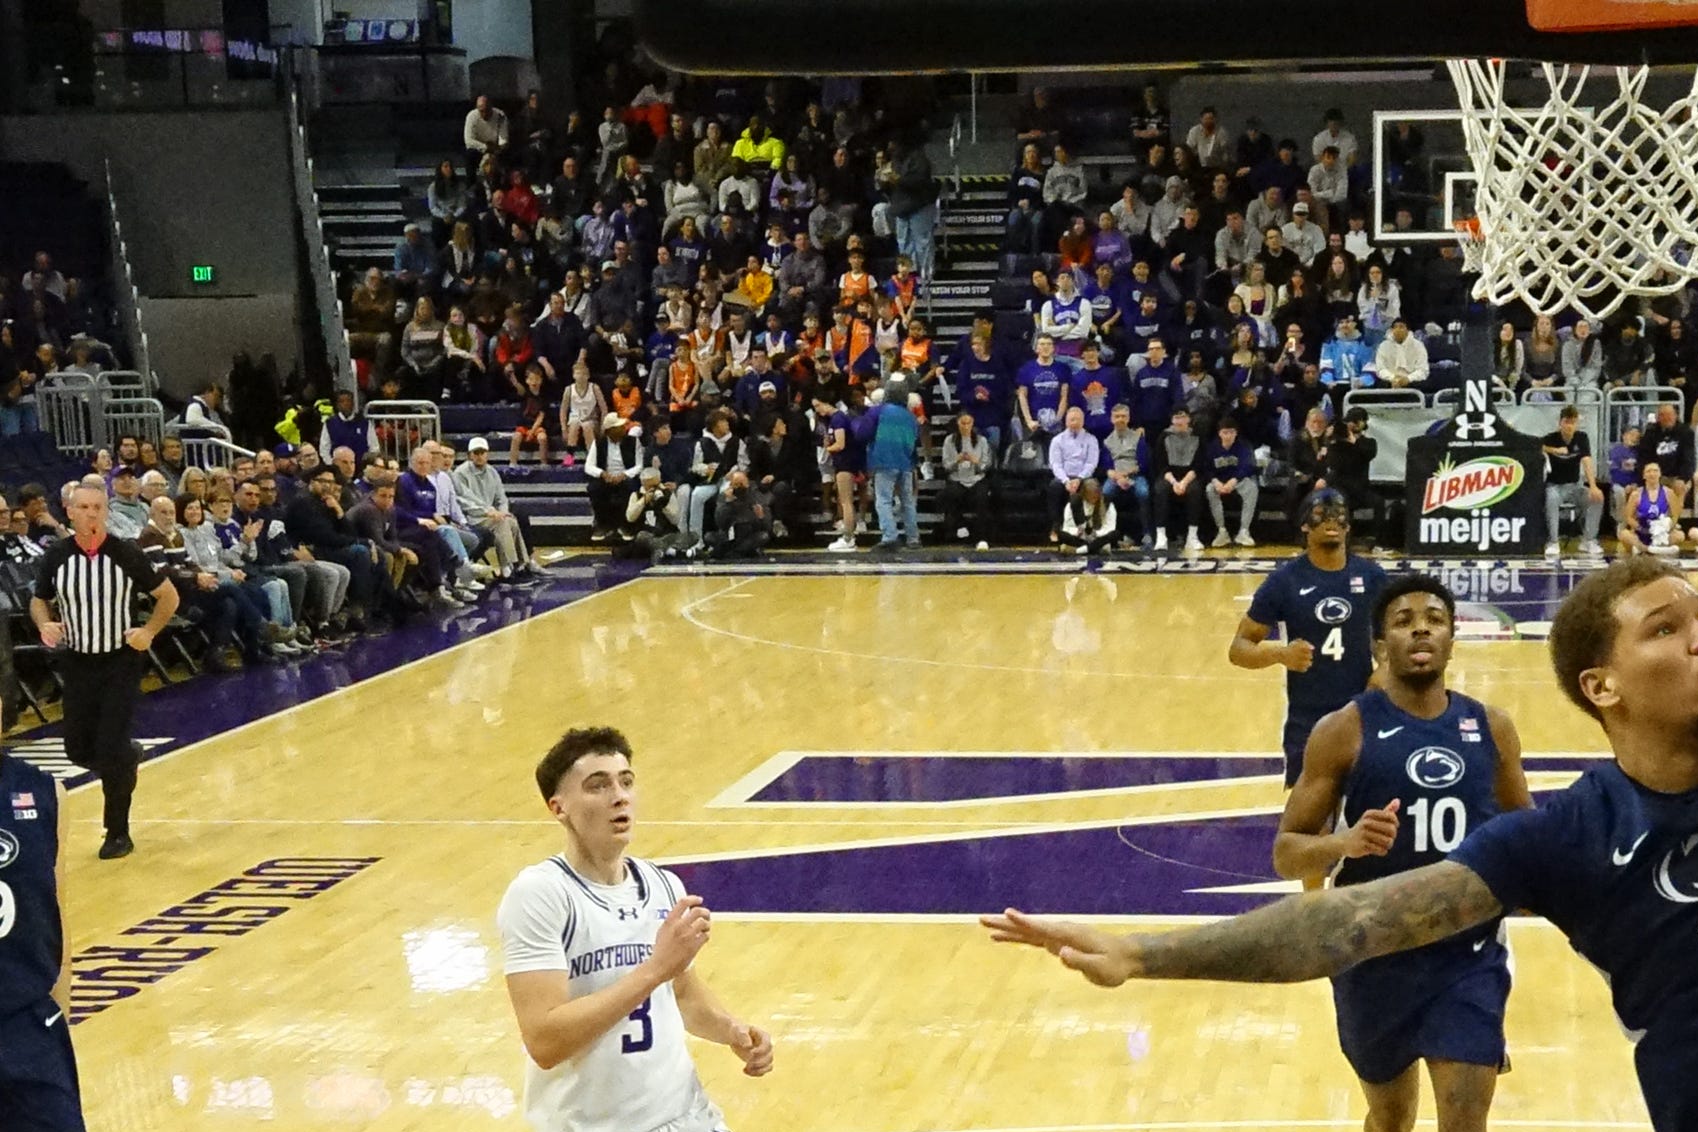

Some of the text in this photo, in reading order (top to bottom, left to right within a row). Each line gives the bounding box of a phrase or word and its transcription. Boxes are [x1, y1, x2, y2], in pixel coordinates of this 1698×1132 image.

[193, 266, 212, 281] EXIT
[971, 286, 990, 294] STEP
[1465, 379, 1487, 412] N
[1424, 464, 1515, 512] LIBMAN
[1420, 507, 1526, 551] meijer
[1321, 628, 1345, 661] 4
[1407, 797, 1466, 852] 10
[621, 996, 653, 1054] 3
